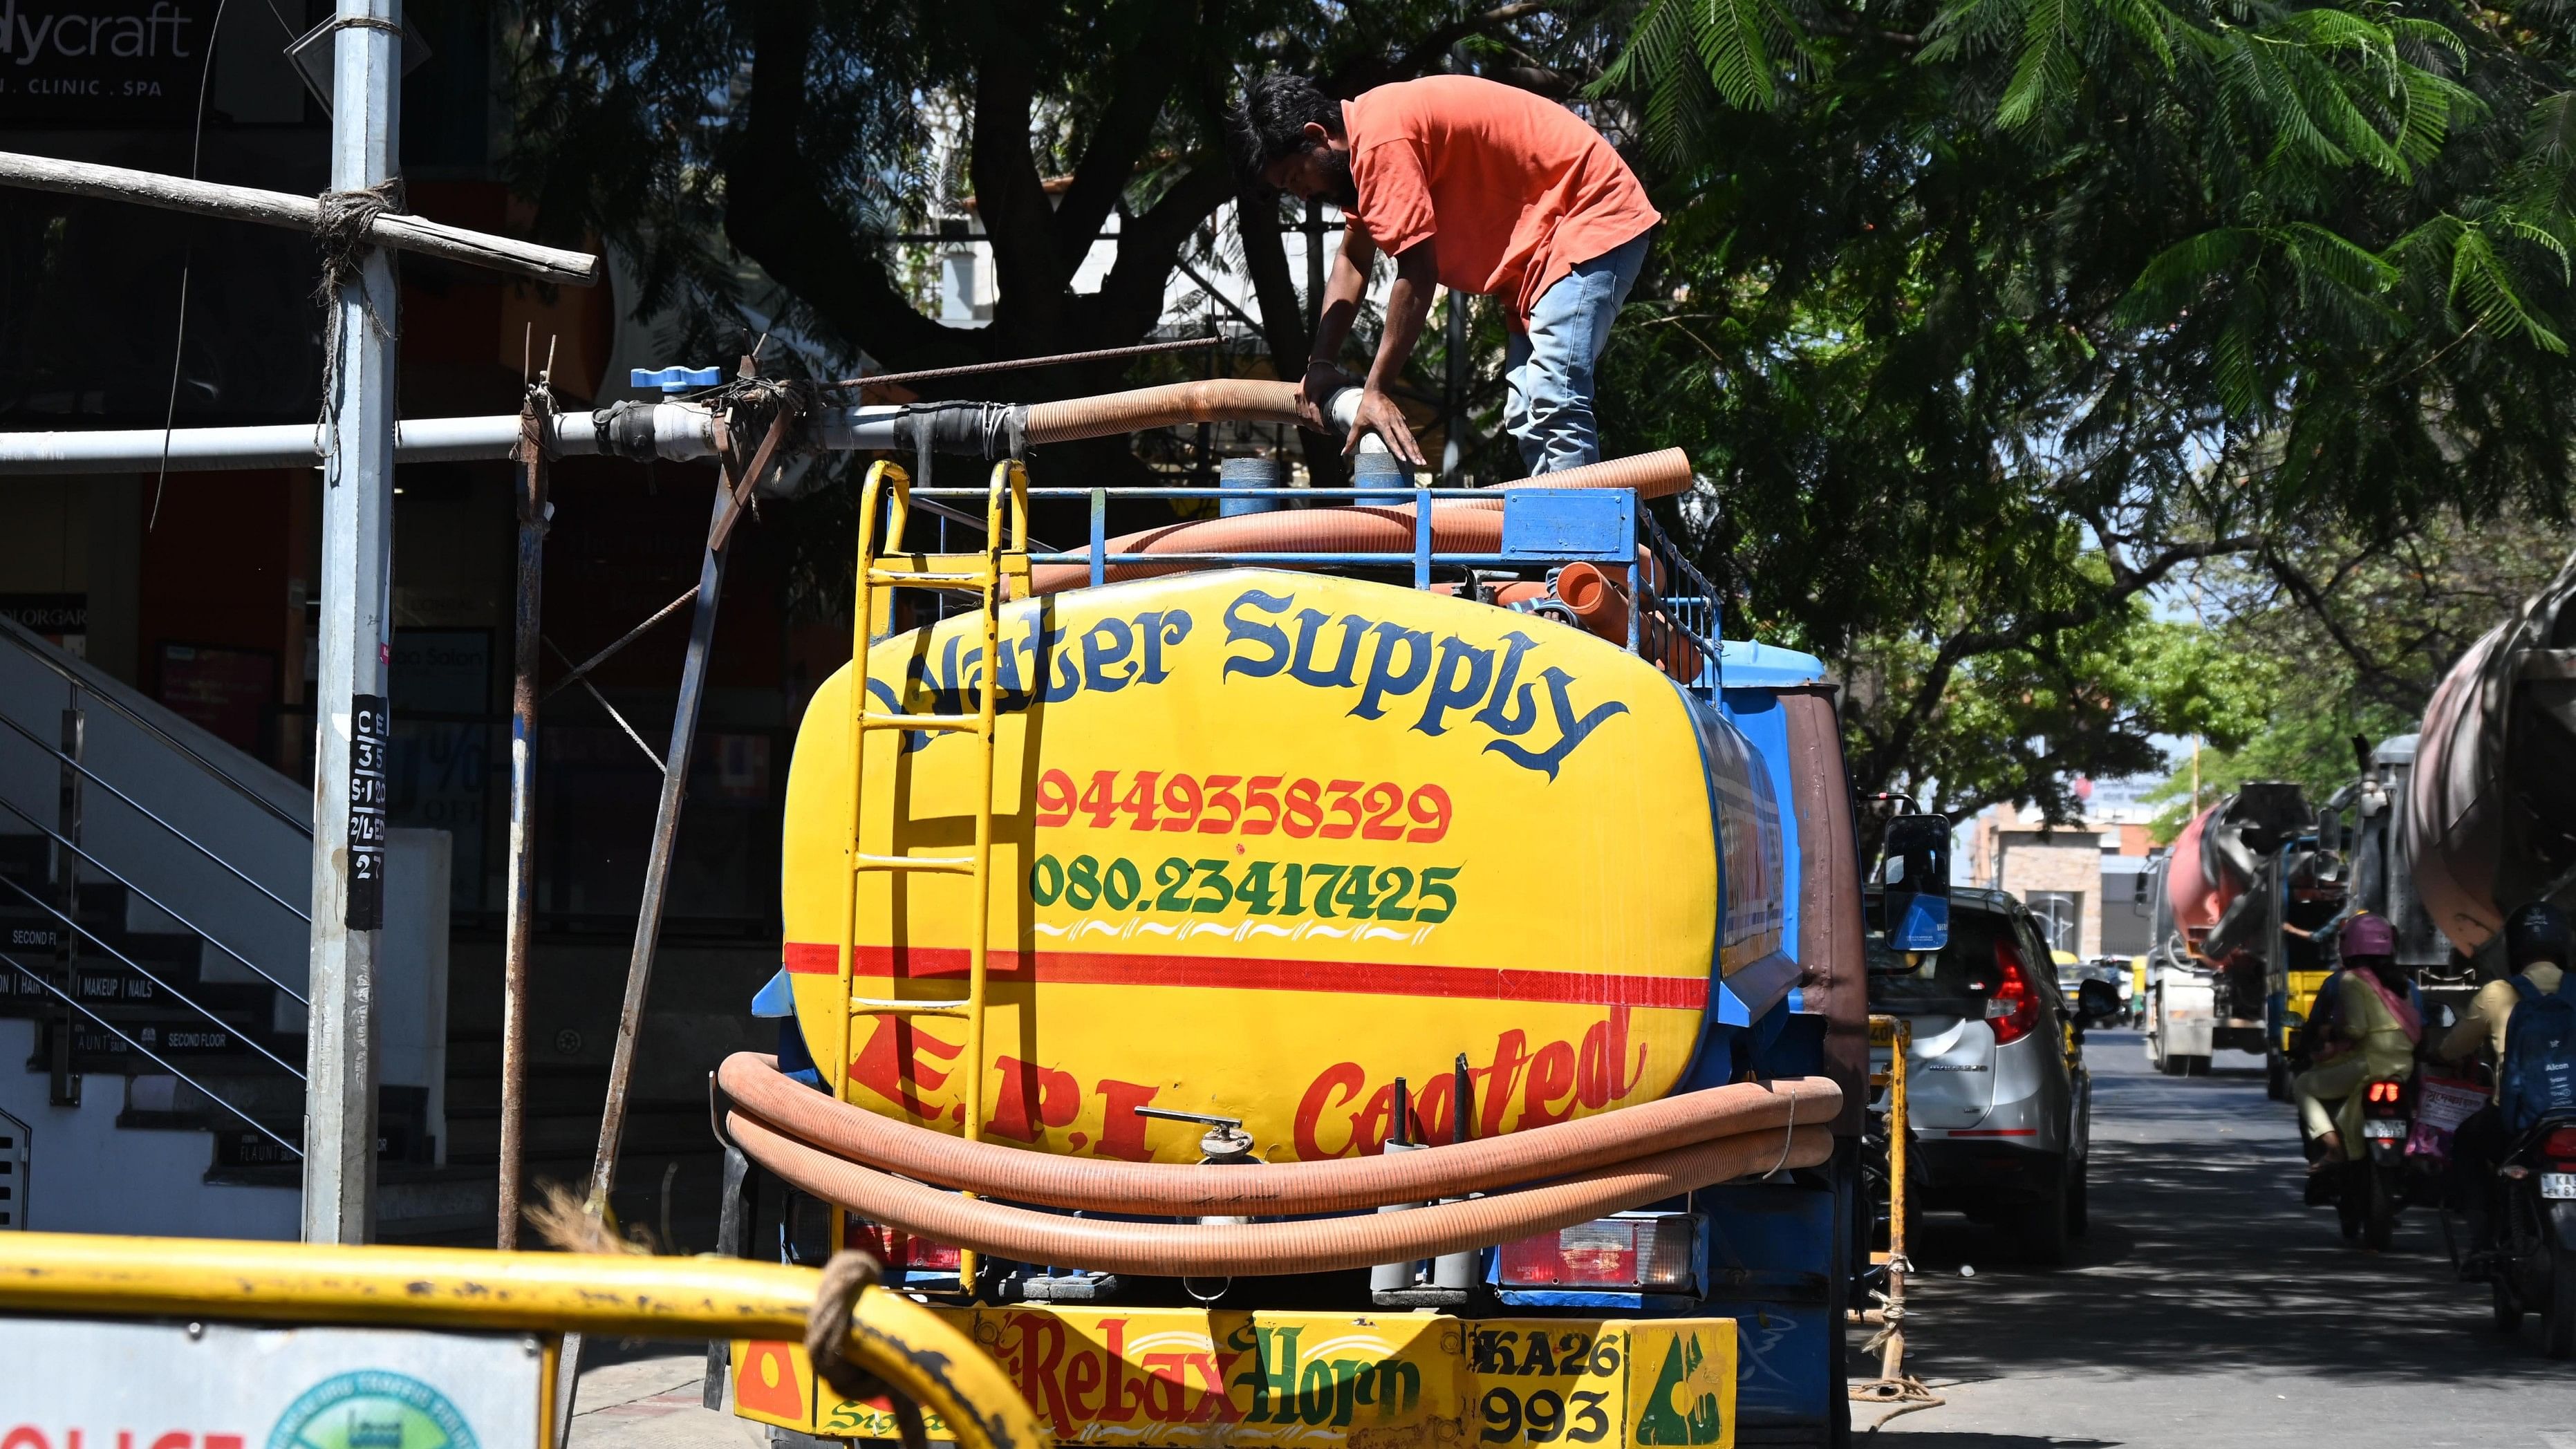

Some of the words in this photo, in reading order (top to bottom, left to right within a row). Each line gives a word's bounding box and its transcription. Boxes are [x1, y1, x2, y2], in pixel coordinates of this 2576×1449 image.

[28, 79, 100, 95] CLINIC
[123, 80, 162, 97] SPA
[866, 605, 1193, 756] Water
[358, 745, 383, 769] 35
[1034, 769, 1453, 844] 9449358329
[356, 854, 382, 879] 27
[1029, 853, 1466, 924] 080.23417425
[13, 931, 47, 945] SECOND
[84, 977, 118, 997] MAKEUP
[128, 979, 153, 998] NAILS
[168, 1033, 199, 1047] SECOND
[200, 1034, 227, 1047] FLOOR
[2545, 1063, 2569, 1072] Alcon
[1294, 1006, 1648, 1162] Coated
[240, 1145, 277, 1161] FLAUNT
[1476, 1329, 1622, 1378] KA26
[1228, 1315, 1421, 1425] Horn
[1479, 1387, 1610, 1445] 993
